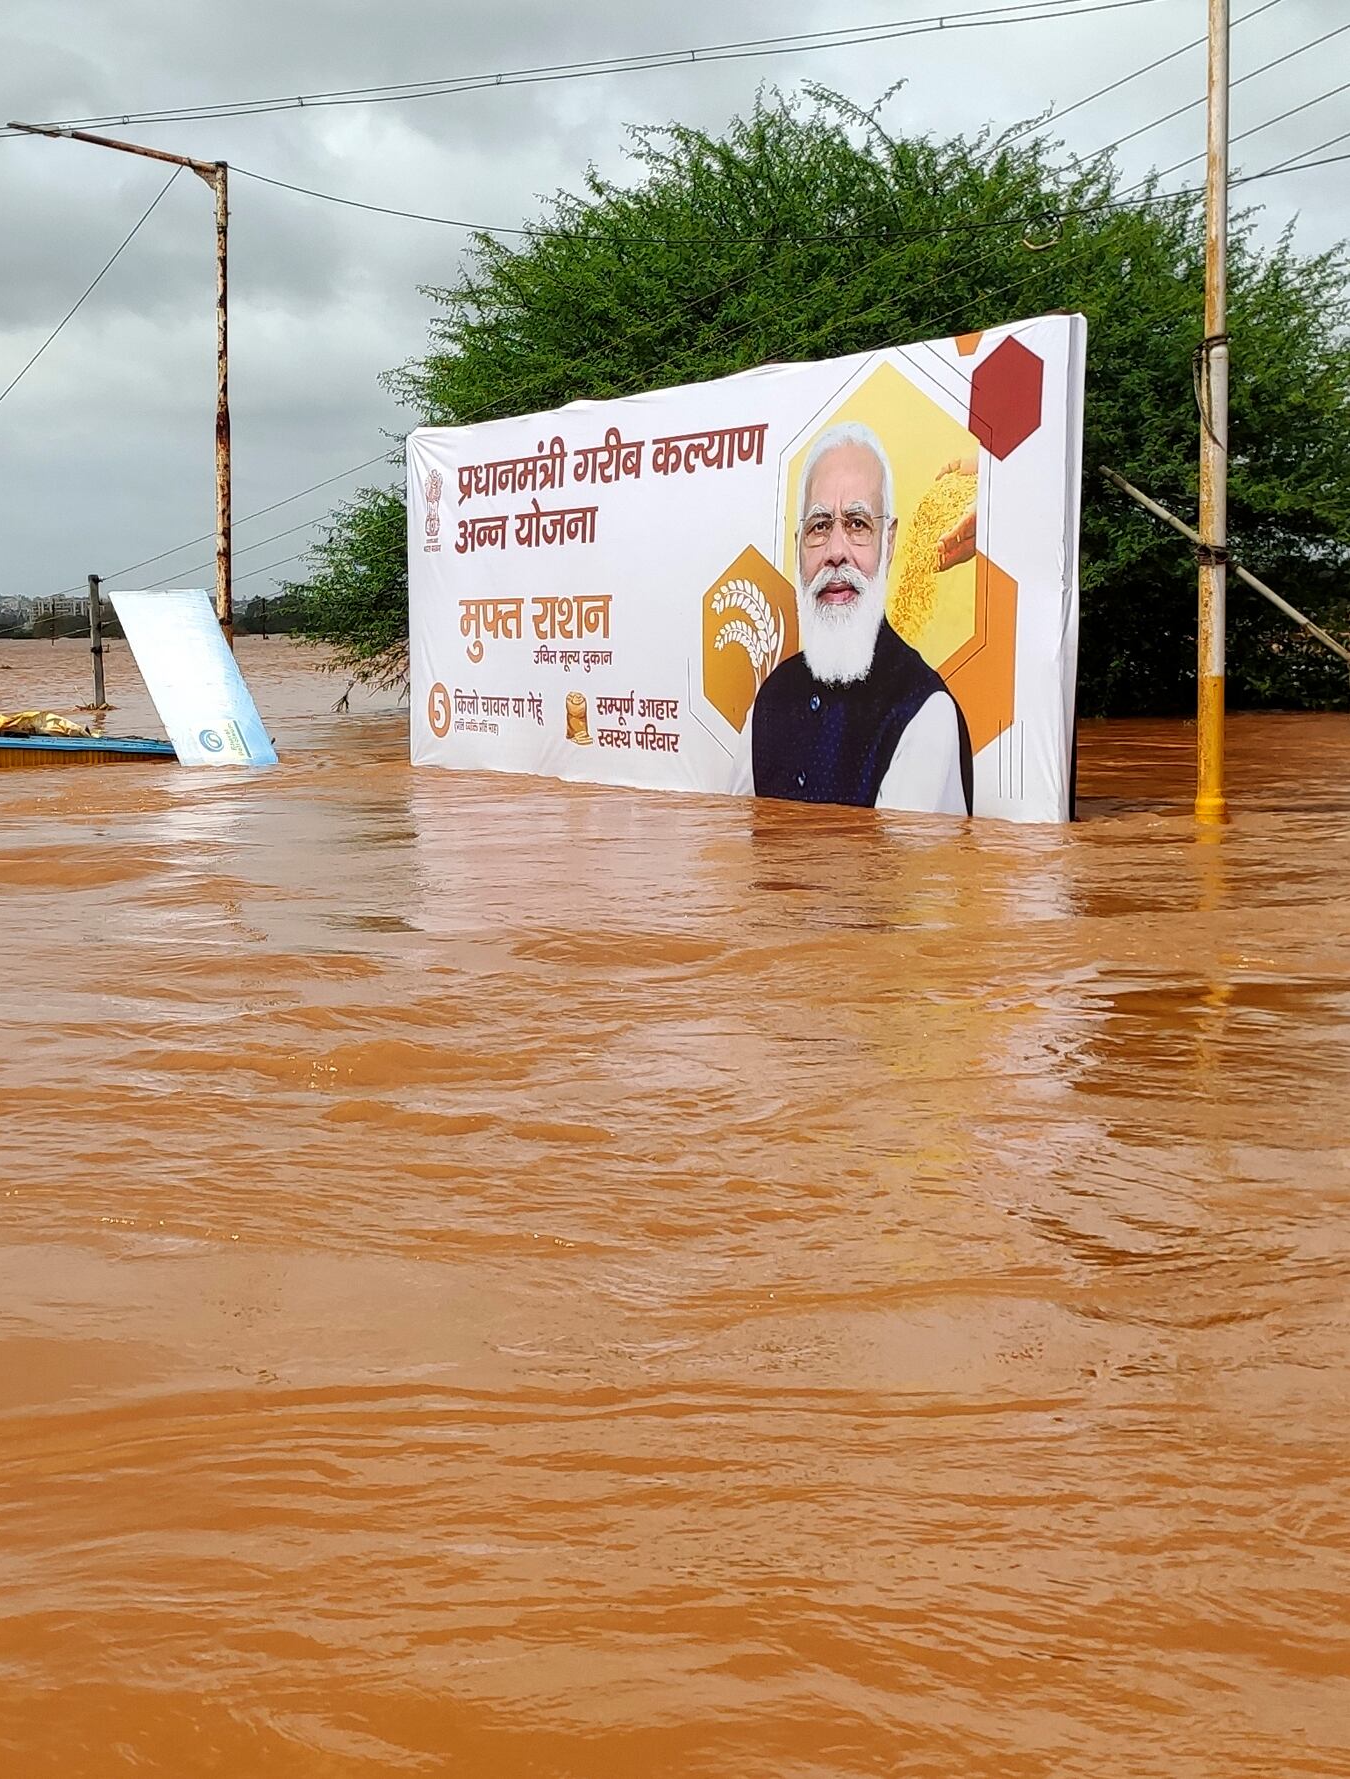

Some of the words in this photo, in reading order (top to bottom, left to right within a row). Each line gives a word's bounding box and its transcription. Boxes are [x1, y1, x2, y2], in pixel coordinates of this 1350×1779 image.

[457, 436, 567, 506] प्रधानमंत्री
[573, 427, 645, 484] गरीब
[652, 423, 769, 475] कल्याण
[454, 515, 509, 554] अन्न
[514, 498, 598, 547] योजना
[459, 598, 524, 663] मुफ्त
[532, 594, 612, 639] राशन
[533, 644, 557, 665] उचित
[559, 650, 580, 672] मूल्य
[582, 650, 612, 673] दुकान
[433, 692, 446, 729] 5
[454, 688, 479, 715] किलो
[481, 696, 510, 716] चावल
[512, 698, 525, 718] या
[527, 691, 544, 726] गेहूं
[596, 690, 634, 726] सम्पूर्ण
[638, 699, 679, 720] आहार
[597, 728, 631, 749] स्वस्थ
[634, 723, 680, 753] परिवार
